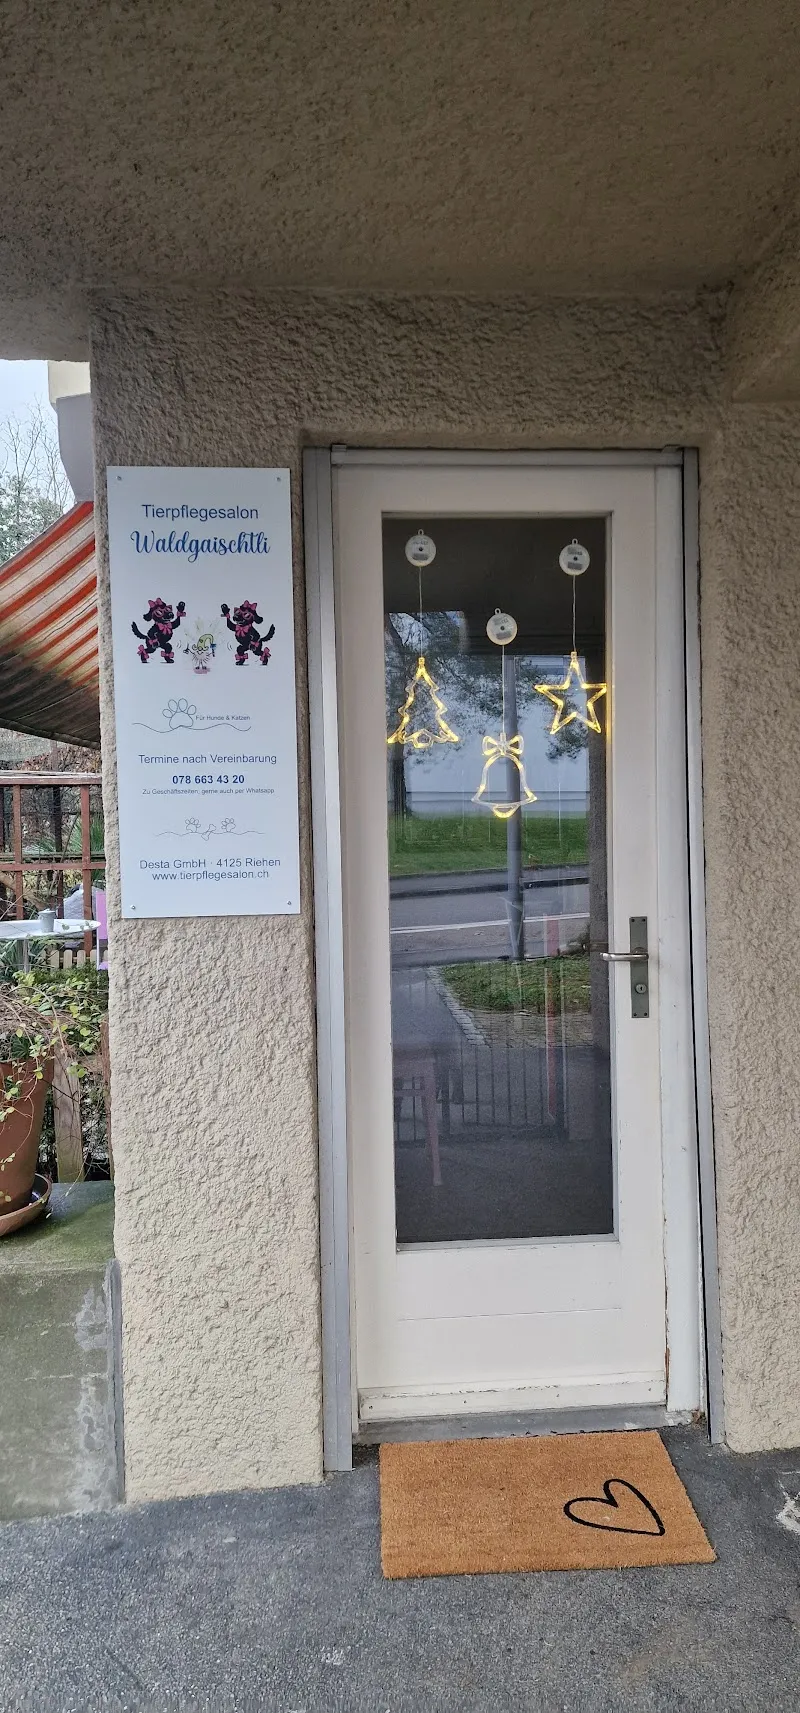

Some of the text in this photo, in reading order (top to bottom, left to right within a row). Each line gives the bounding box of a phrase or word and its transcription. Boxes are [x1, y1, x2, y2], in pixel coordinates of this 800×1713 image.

[142, 504, 259, 522] Tierpflegesalon
[130, 530, 271, 563] Waldgaischtli
[139, 753, 277, 764] Termine nach Vereinbarung
[172, 774, 245, 784] 078 663 43 20
[140, 859, 170, 869] Desta
[173, 858, 206, 868] GmbH
[216, 858, 242, 867] 4125
[245, 857, 281, 867] Riehen
[152, 870, 269, 881] www.tierpflegesalon.ch
